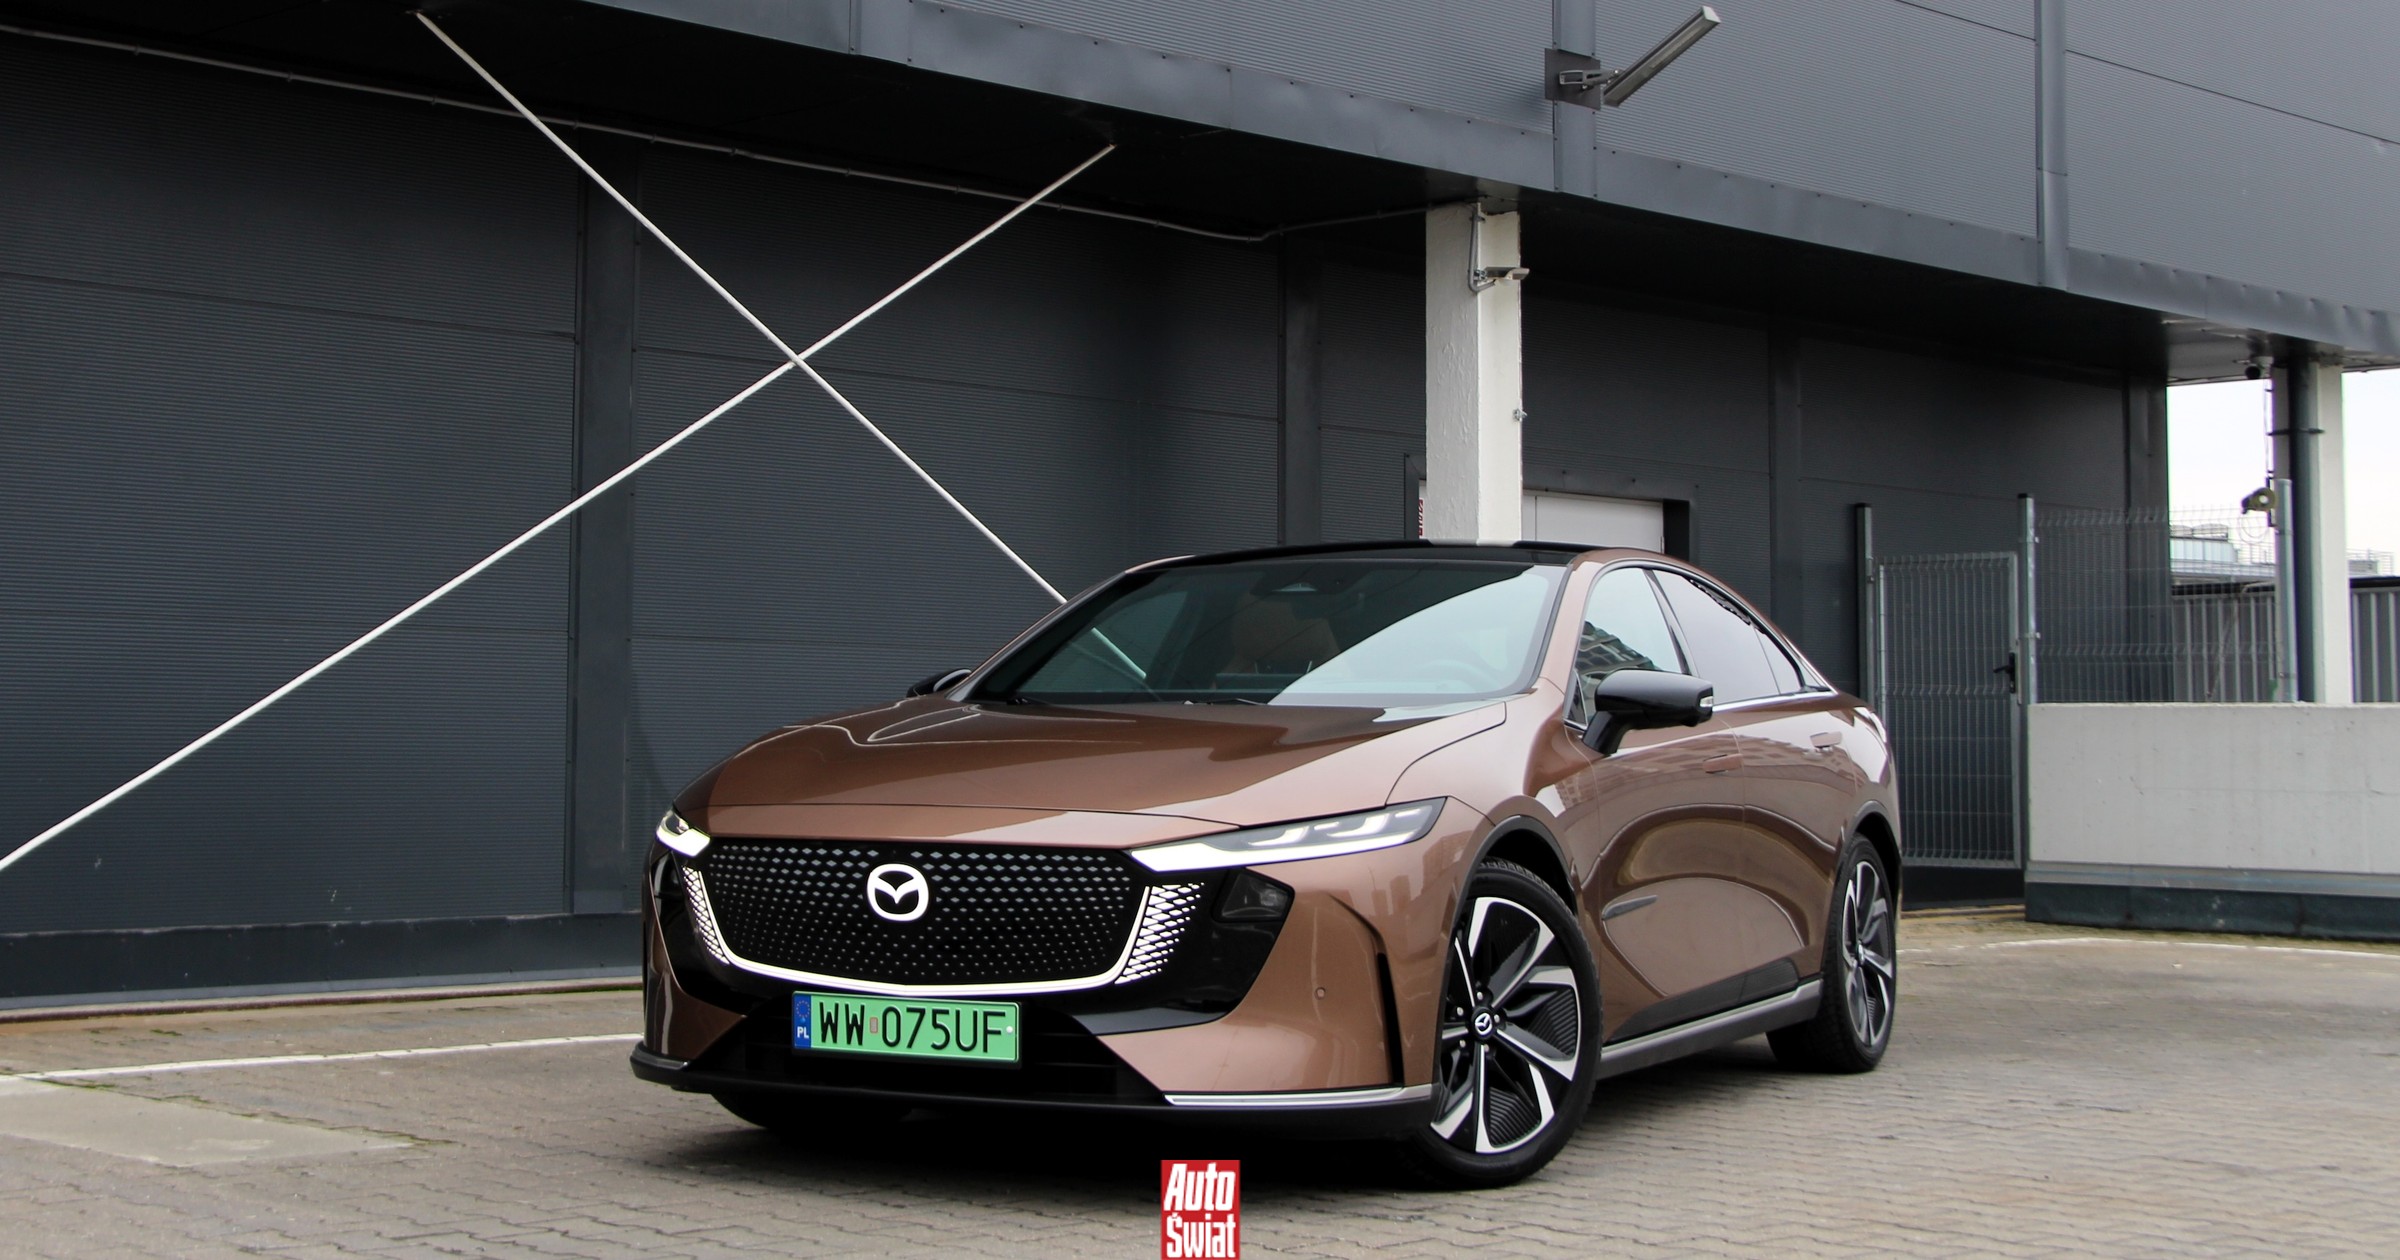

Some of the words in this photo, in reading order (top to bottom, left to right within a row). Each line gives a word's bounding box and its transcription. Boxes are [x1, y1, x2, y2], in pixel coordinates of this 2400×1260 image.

[797, 1026, 810, 1039] PL
[819, 1001, 865, 1046] WW
[881, 1006, 1006, 1053] 075UF
